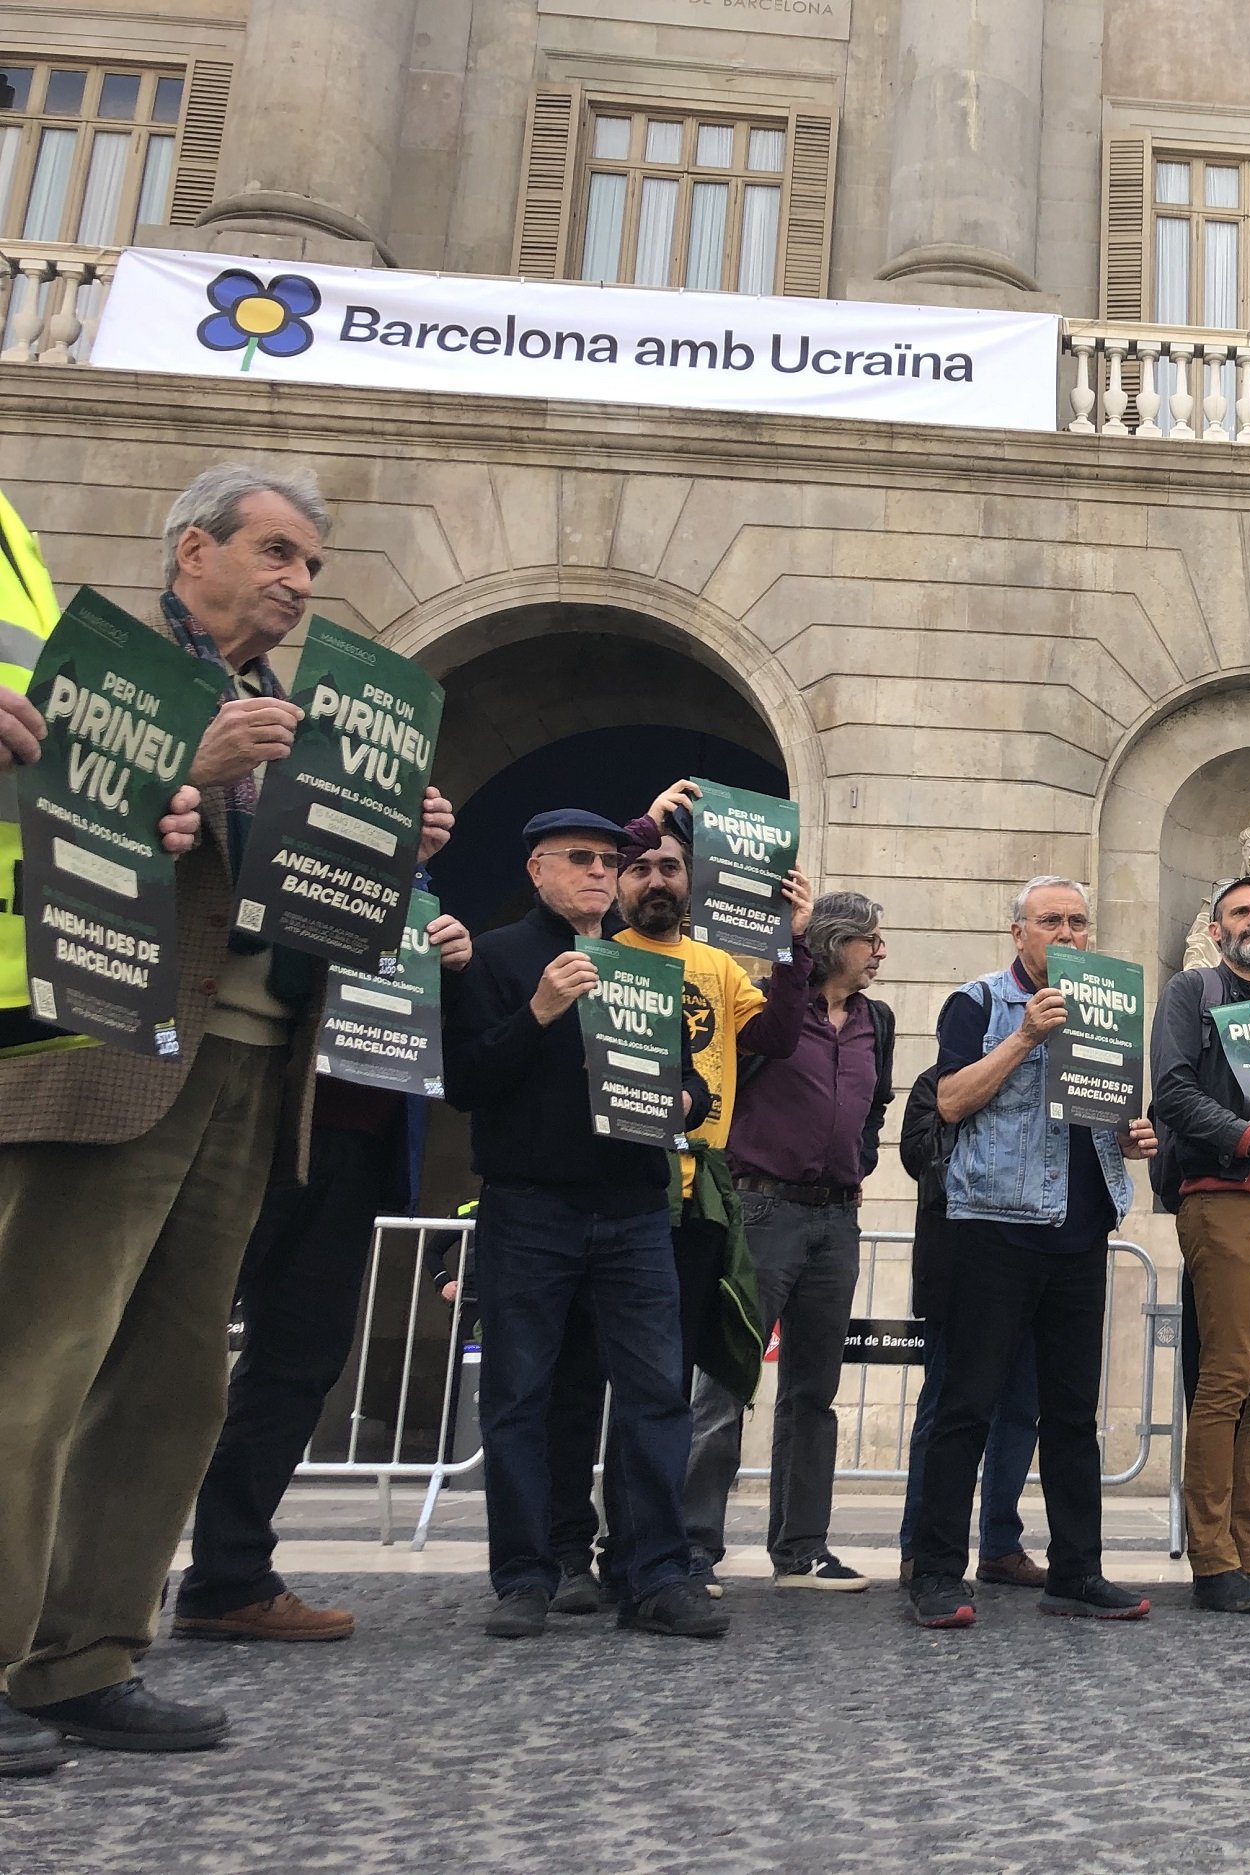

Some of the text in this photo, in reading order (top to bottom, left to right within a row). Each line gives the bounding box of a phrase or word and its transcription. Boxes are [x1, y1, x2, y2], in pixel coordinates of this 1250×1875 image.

[338, 304, 974, 383] Barcelona amb Ucraïna
[101, 671, 161, 718] PER UN
[363, 683, 415, 721] PER UN
[45, 674, 186, 782] PIRINEU
[310, 684, 431, 772] PIRINEU
[69, 742, 131, 816] VIU.
[341, 735, 402, 797] VIU.
[296, 772, 413, 829] ATUREM ELS JOCS OLÍMPICS
[728, 807, 765, 823] PER UN
[36, 796, 153, 858] ATUREM ELS JOCS OLÍMPICS
[703, 811, 792, 849] PIRINEU
[726, 834, 771, 864] VIU.
[271, 849, 352, 888] ANEM-HI
[351, 875, 382, 900] DES
[380, 888, 400, 907] DE
[281, 874, 387, 924] BARCELONA!
[704, 898, 781, 926] ANEM-HI DES DE
[41, 903, 104, 946] ANEM-HI
[106, 928, 135, 958] DES
[138, 940, 160, 964] DE
[712, 911, 774, 935] BARCELONA!
[56, 937, 149, 990] BARCELONA!
[328, 964, 358, 978] ATUREM
[358, 972, 372, 981] ELS
[392, 980, 424, 995] OLÍMPICS
[614, 969, 651, 988] PER UN
[1083, 972, 1115, 988] PER UN
[587, 979, 674, 1018] PIRINEU
[1060, 978, 1137, 1015] PIRINEU
[325, 1017, 428, 1049] ANEM-HI DES DE
[608, 1006, 653, 1038] VIU.
[1079, 1004, 1120, 1032] VIU.
[335, 1034, 418, 1062] BARCELONA!
[1062, 1029, 1085, 1040] ATUREM
[1094, 1035, 1109, 1044] JOCS
[601, 1080, 674, 1106] ANEM-HI DES DE
[1060, 1072, 1134, 1094] ANEM-HI DES DE
[1068, 1085, 1127, 1105] BARCELONA!
[610, 1096, 668, 1119] BARCELONA!
[864, 1335, 925, 1348] de Barcelo
